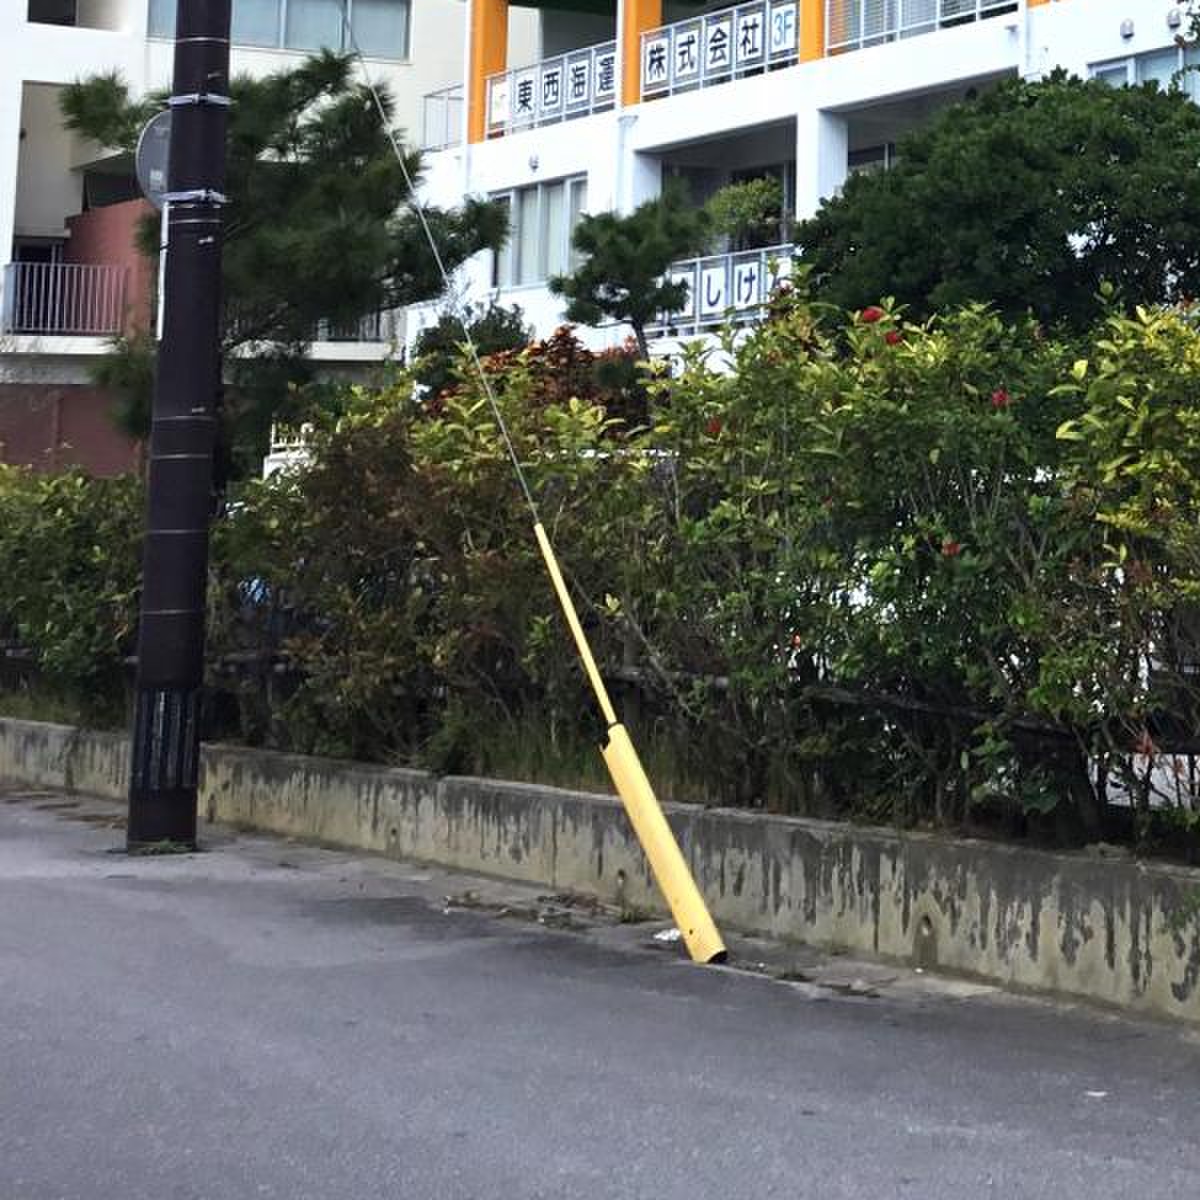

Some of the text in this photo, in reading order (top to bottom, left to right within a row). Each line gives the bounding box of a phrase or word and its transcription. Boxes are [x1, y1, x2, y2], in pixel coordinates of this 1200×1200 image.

[648, 20, 760, 81] 株式会社
[773, 10, 795, 47] 3F
